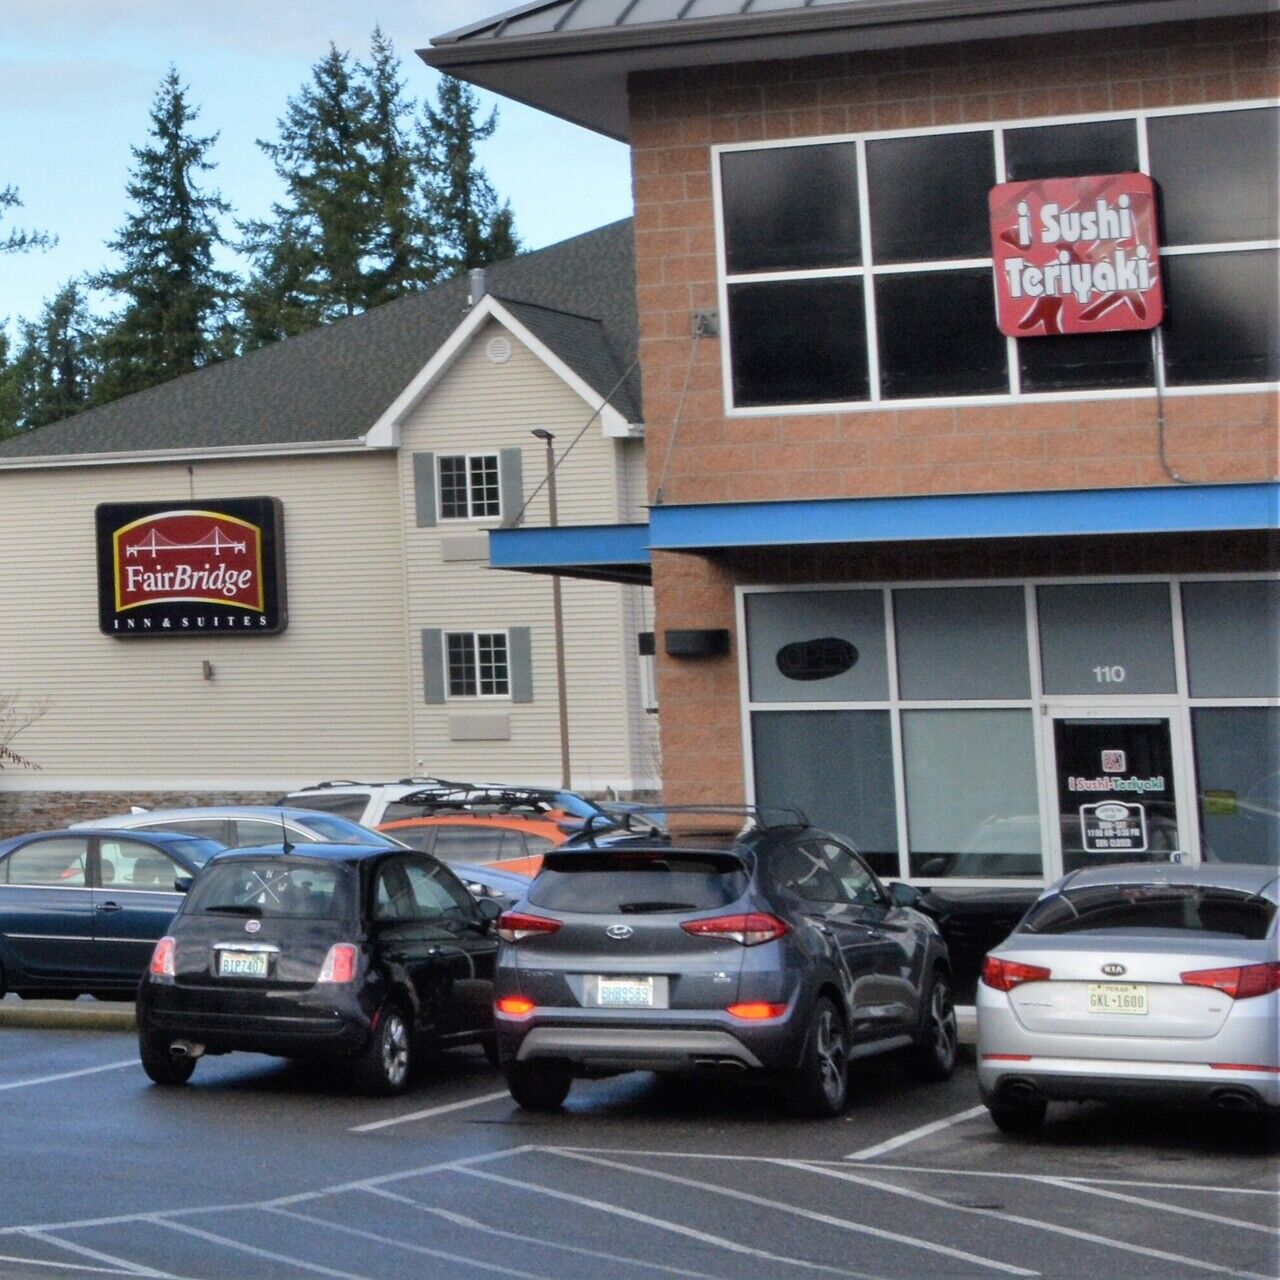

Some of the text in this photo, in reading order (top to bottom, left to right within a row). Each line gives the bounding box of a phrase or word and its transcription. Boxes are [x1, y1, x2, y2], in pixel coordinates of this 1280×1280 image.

[1017, 194, 1132, 245] i Sushi
[1005, 245, 1151, 304] Teriyaki
[126, 563, 252, 596] FairBridge
[114, 616, 267, 629] INN & SUITES
[1092, 665, 1126, 682] 110
[1103, 965, 1125, 975] KIA
